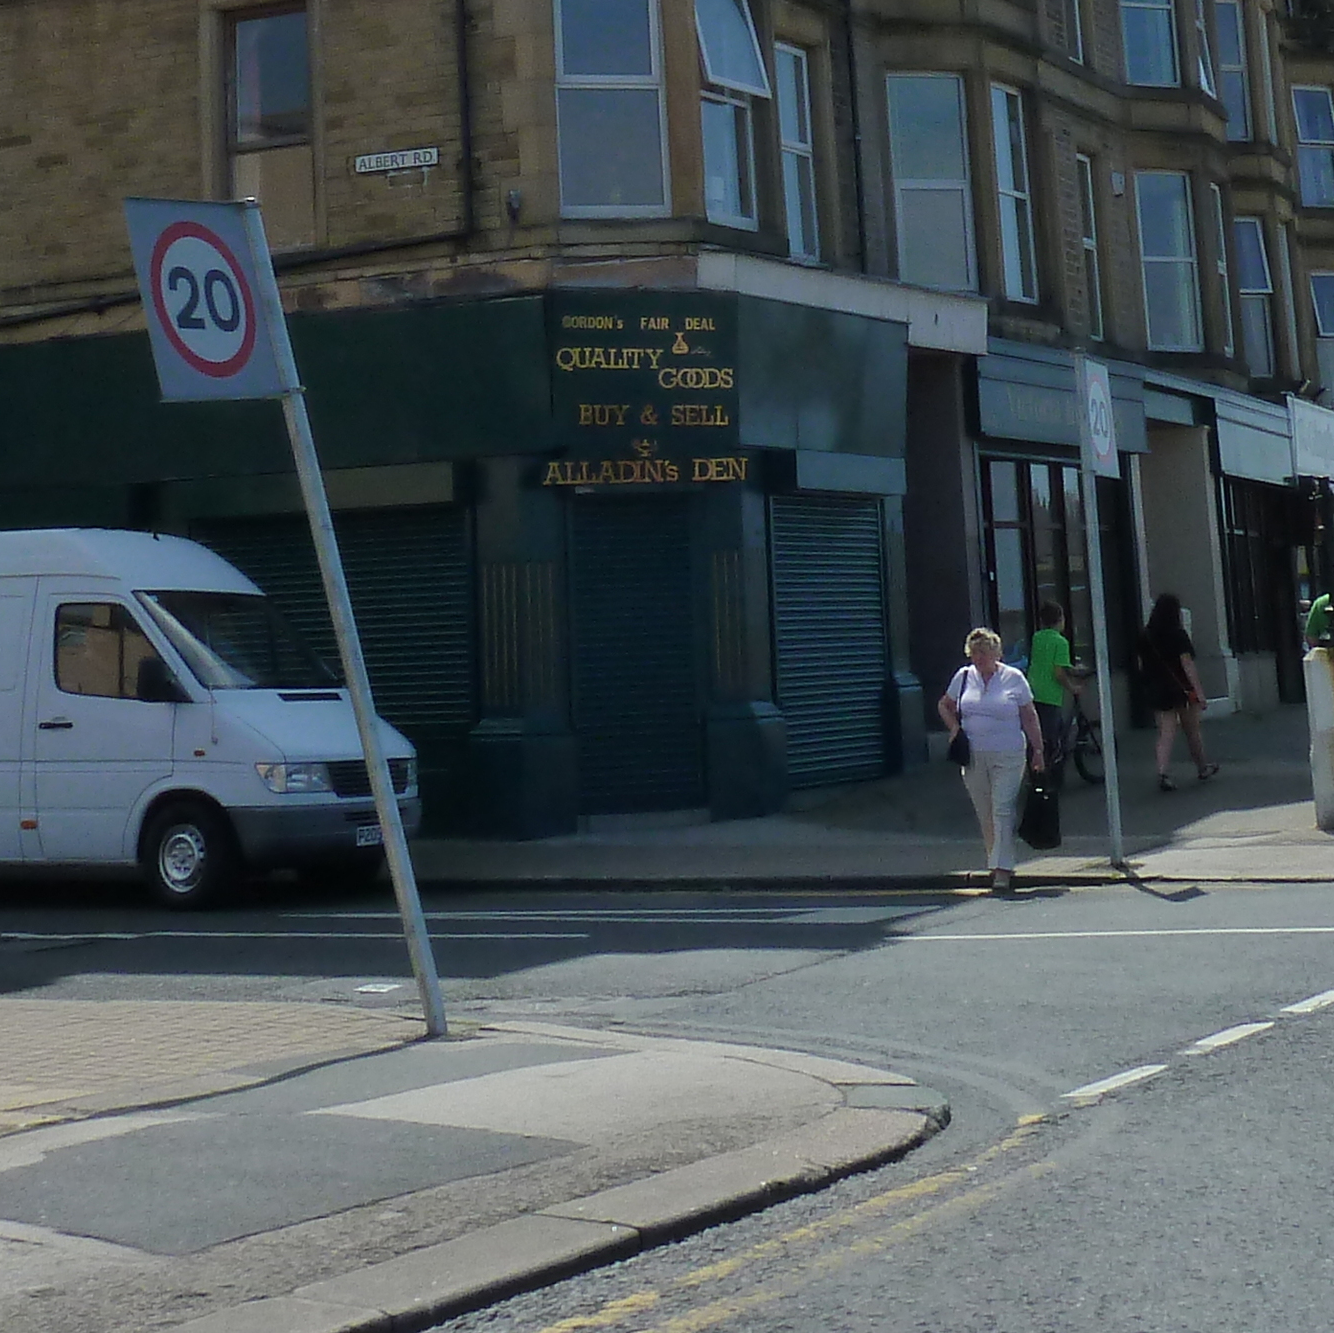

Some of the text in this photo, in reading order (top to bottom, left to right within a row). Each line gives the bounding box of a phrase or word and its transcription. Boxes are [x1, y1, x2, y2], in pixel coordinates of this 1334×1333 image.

[358, 150, 433, 171] ALBERT RD
[168, 266, 241, 333] 20
[562, 315, 716, 331] GORDON's FAIR DEAL
[556, 347, 664, 371] QUALITY
[658, 367, 734, 389] GOODS
[579, 404, 729, 427] BUY & SELL
[1090, 398, 1110, 439] 20
[543, 457, 749, 486] ALLADIN's DEN
